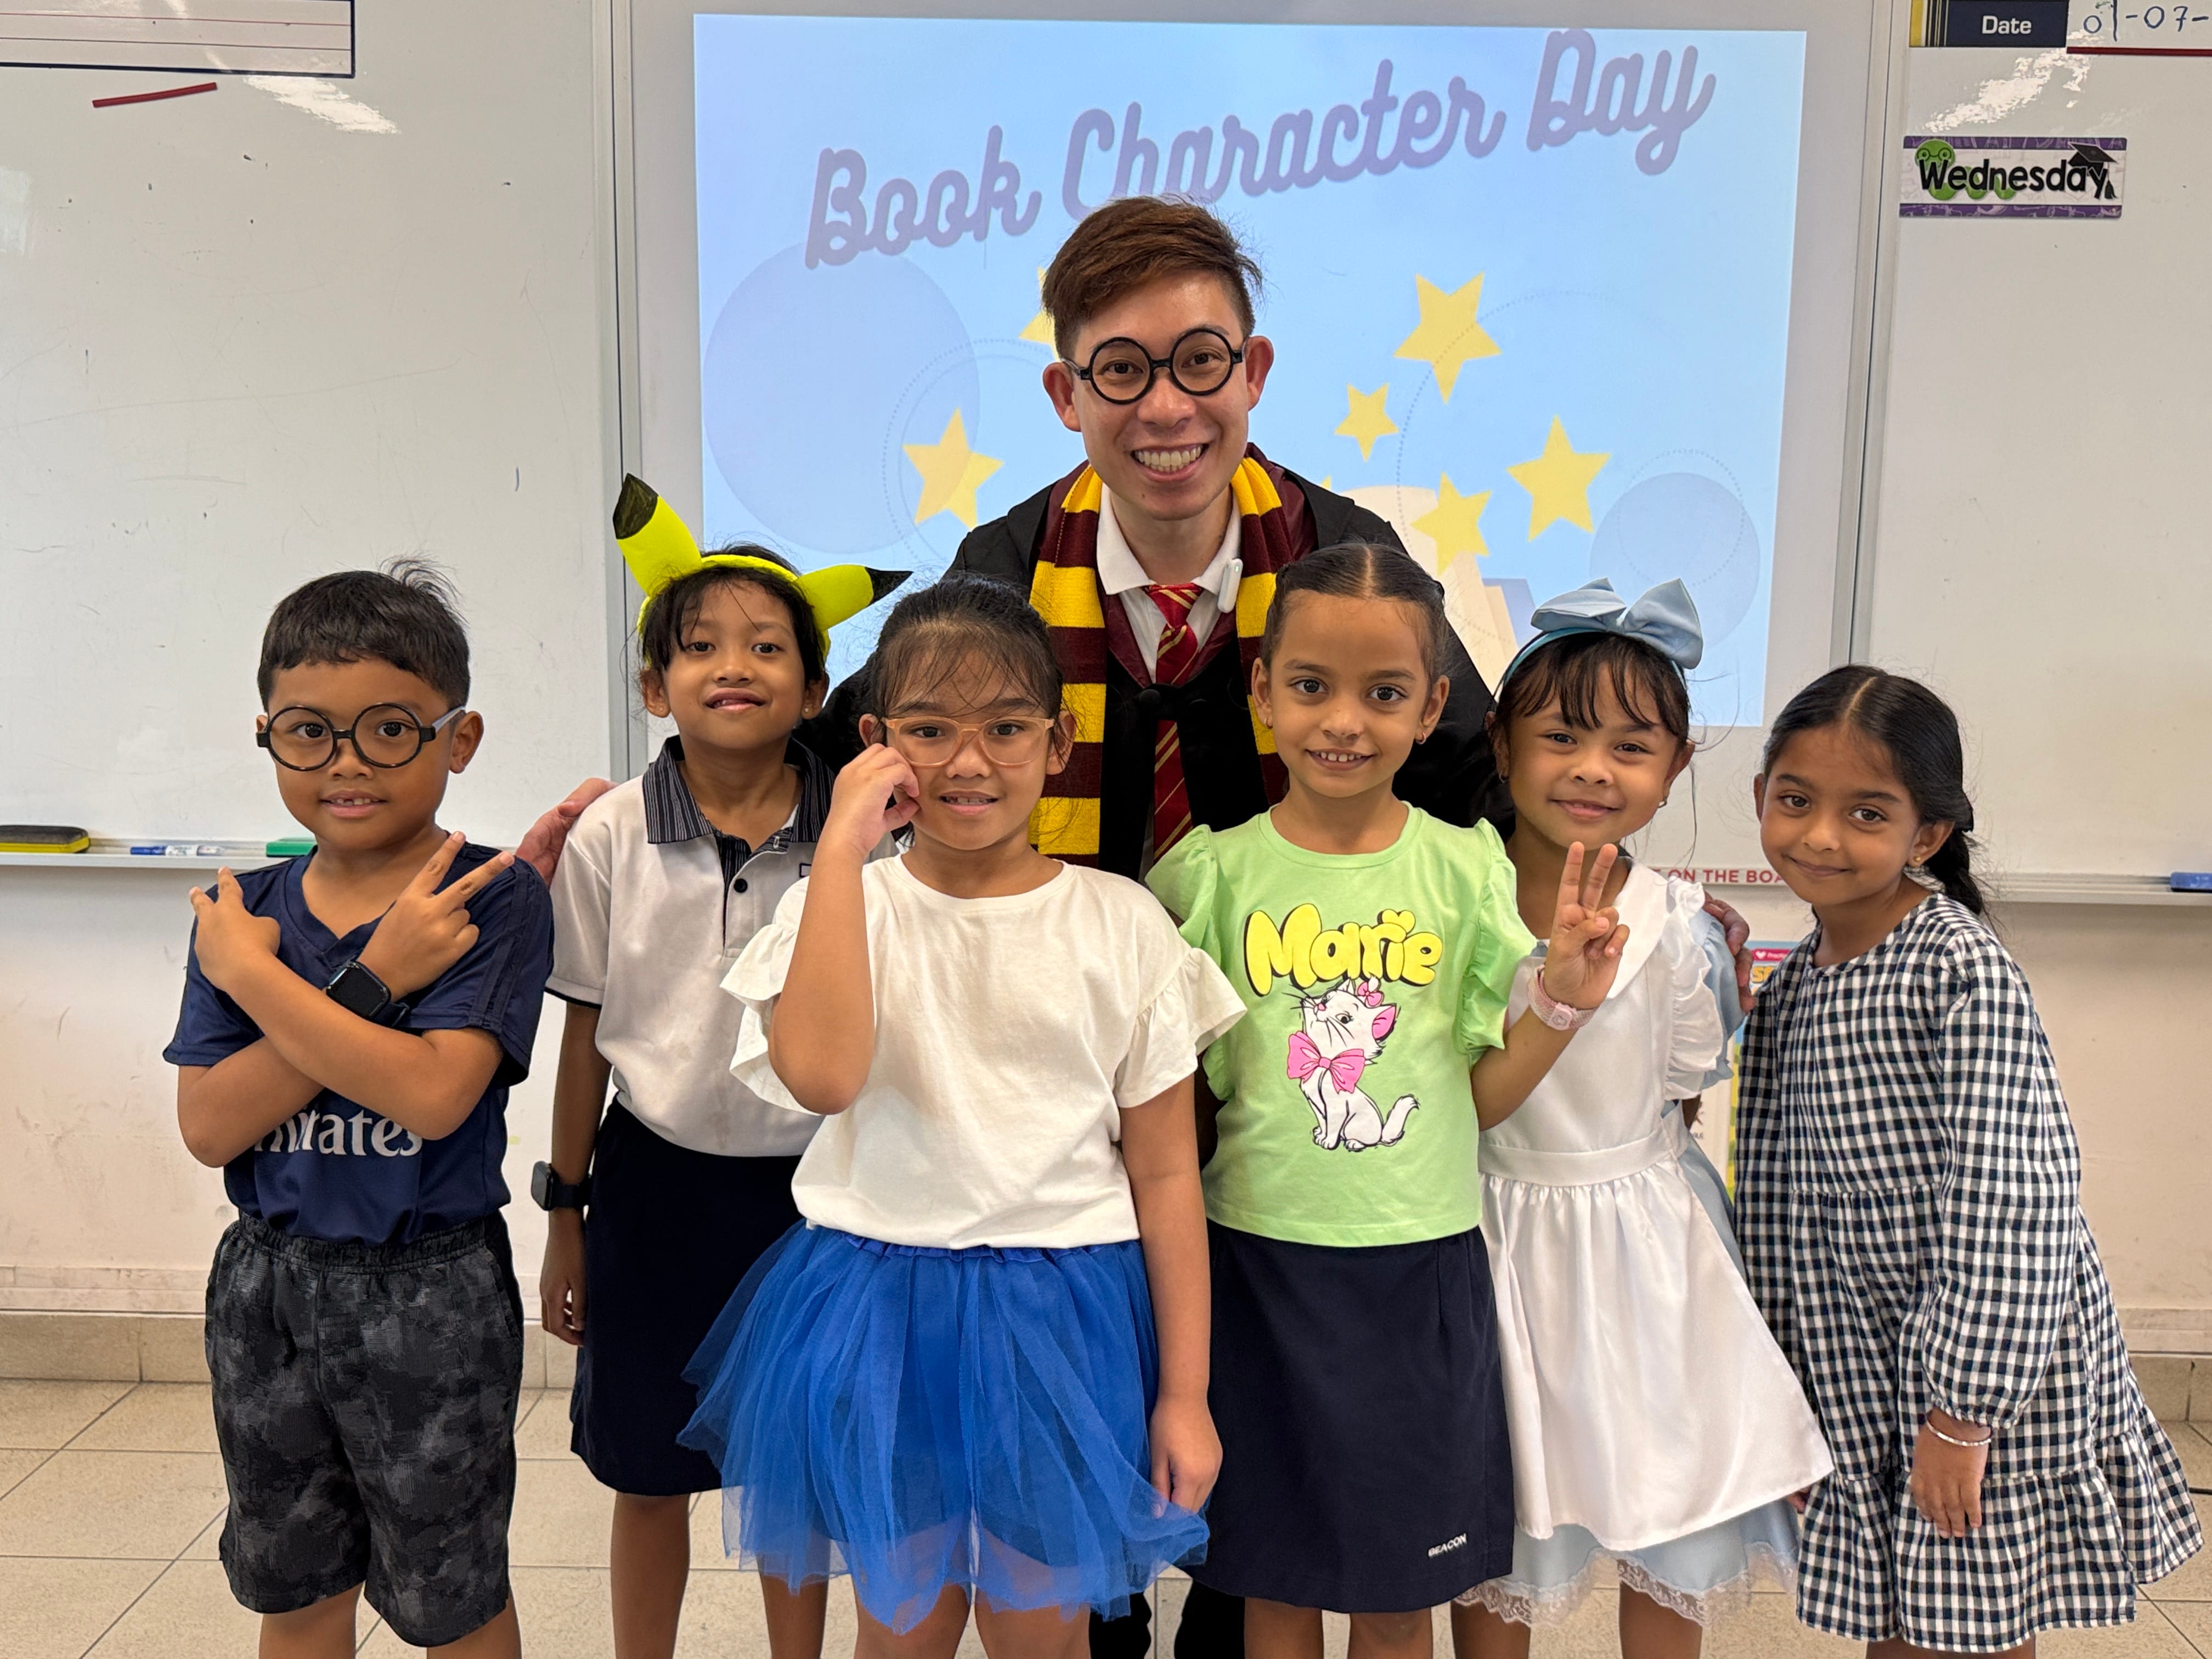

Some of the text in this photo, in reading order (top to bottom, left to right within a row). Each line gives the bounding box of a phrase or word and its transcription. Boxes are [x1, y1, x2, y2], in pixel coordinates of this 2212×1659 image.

[1982, 15, 2032, 35] Date
[805, 29, 1717, 270] Book Character Day
[1918, 159, 2108, 199] Wednesday
[1668, 869, 1695, 882] ON
[1703, 870, 1739, 883] THE
[1244, 903, 1443, 997] Marie
[254, 1109, 422, 1156] mirates
[1428, 1533, 1468, 1557] BEACON
